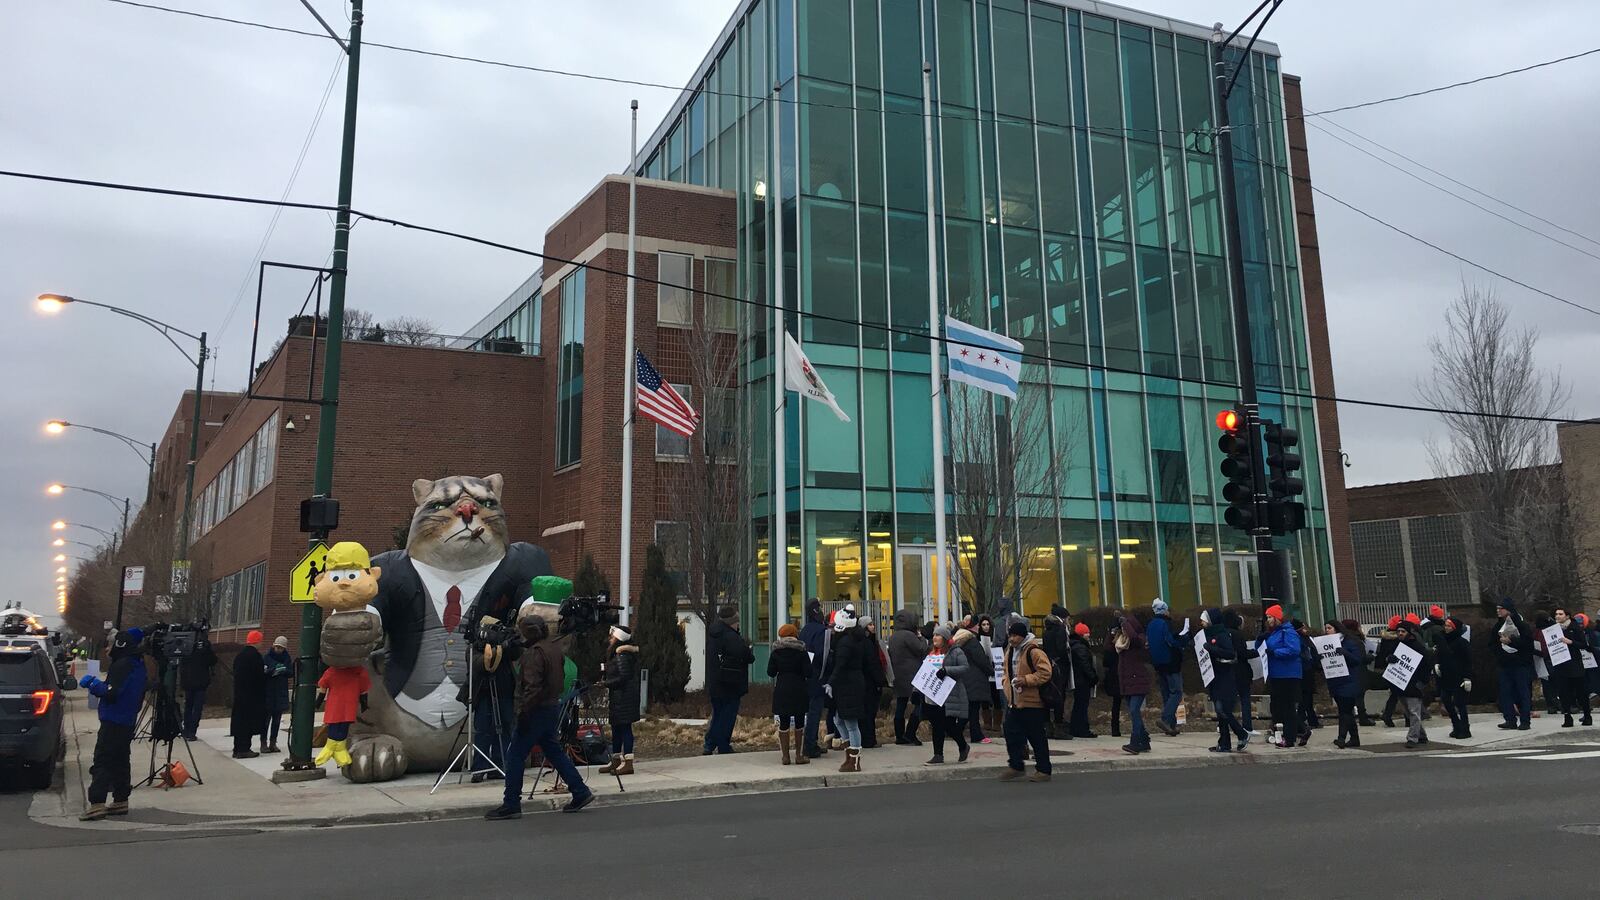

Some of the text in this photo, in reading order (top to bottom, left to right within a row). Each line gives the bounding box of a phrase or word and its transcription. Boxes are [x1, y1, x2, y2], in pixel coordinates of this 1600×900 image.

[1548, 639, 1562, 647] HUELG
[1401, 655, 1412, 663] ON
[1396, 659, 1415, 673] TRIKE
[921, 672, 928, 680] Un
[922, 670, 936, 690] contrato
